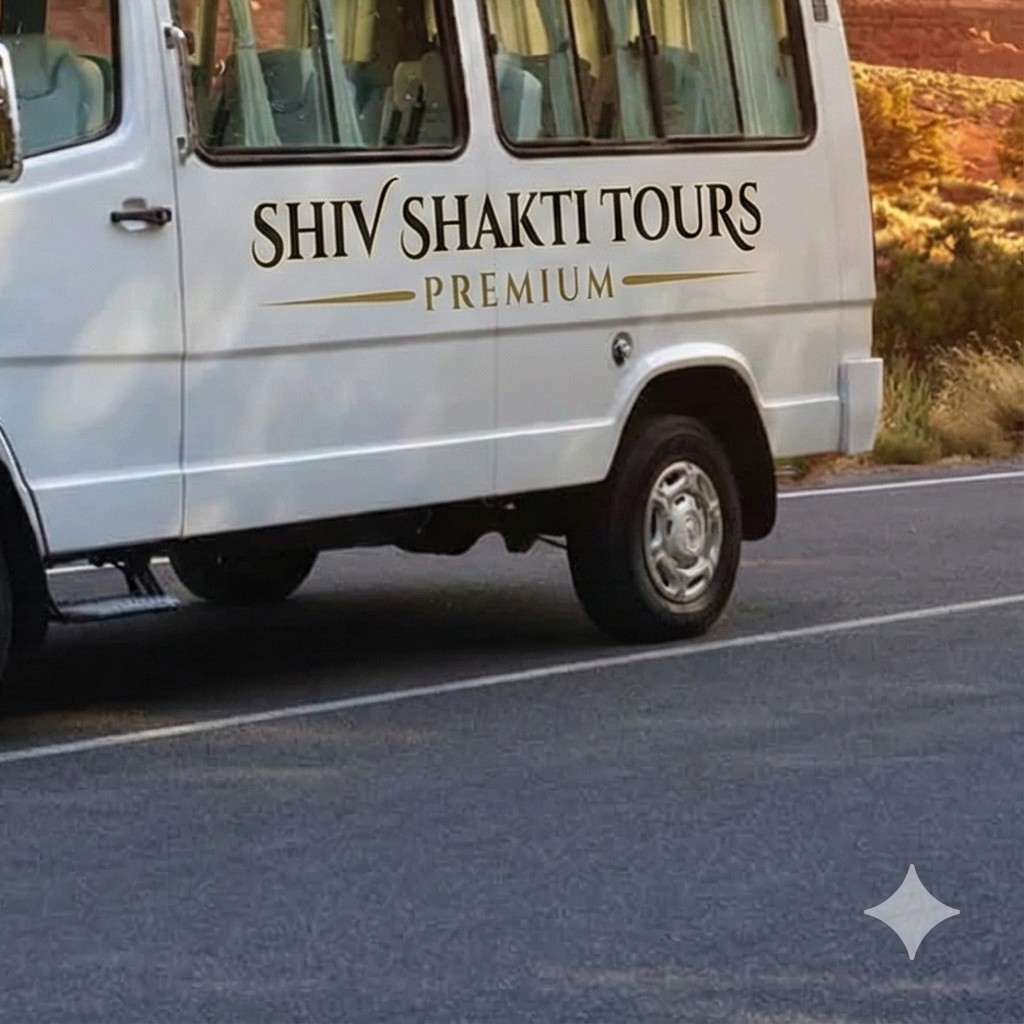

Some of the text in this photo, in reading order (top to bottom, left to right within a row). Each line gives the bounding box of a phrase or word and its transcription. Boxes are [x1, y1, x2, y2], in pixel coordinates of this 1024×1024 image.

[252, 177, 762, 268] SHIV SHAKTI TOURS
[425, 265, 616, 312] PREMIUM
